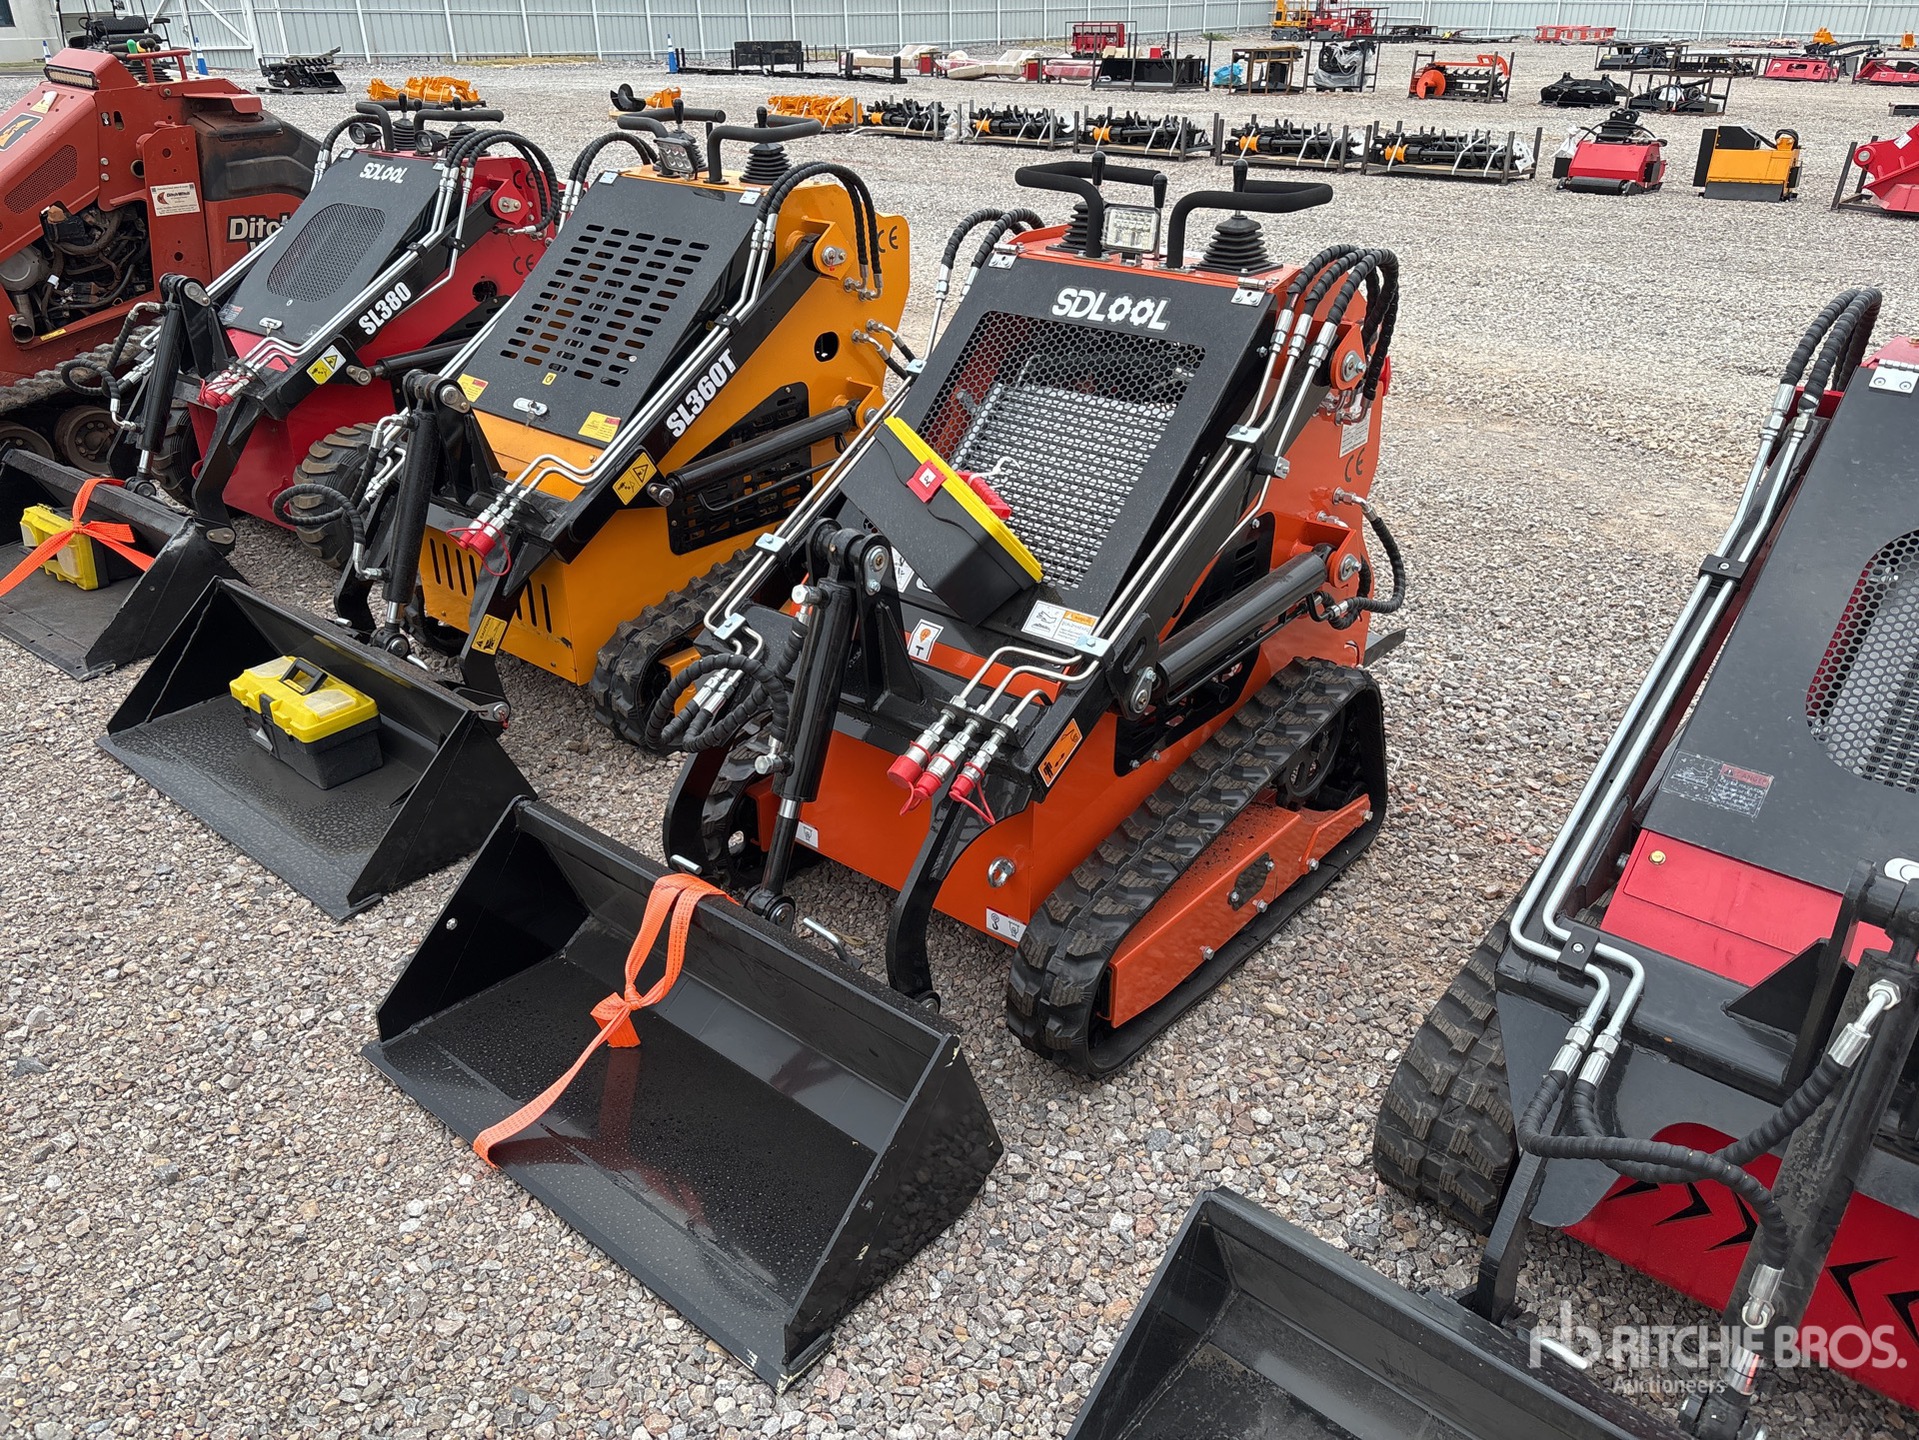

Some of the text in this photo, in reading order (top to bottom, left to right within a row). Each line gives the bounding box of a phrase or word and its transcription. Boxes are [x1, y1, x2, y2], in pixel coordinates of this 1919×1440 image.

[359, 162, 408, 184] SDLOOL
[229, 215, 288, 240] Ditc
[358, 281, 412, 336] SL380
[1051, 287, 1169, 331] SDLOOL
[666, 347, 737, 438] SL360T
